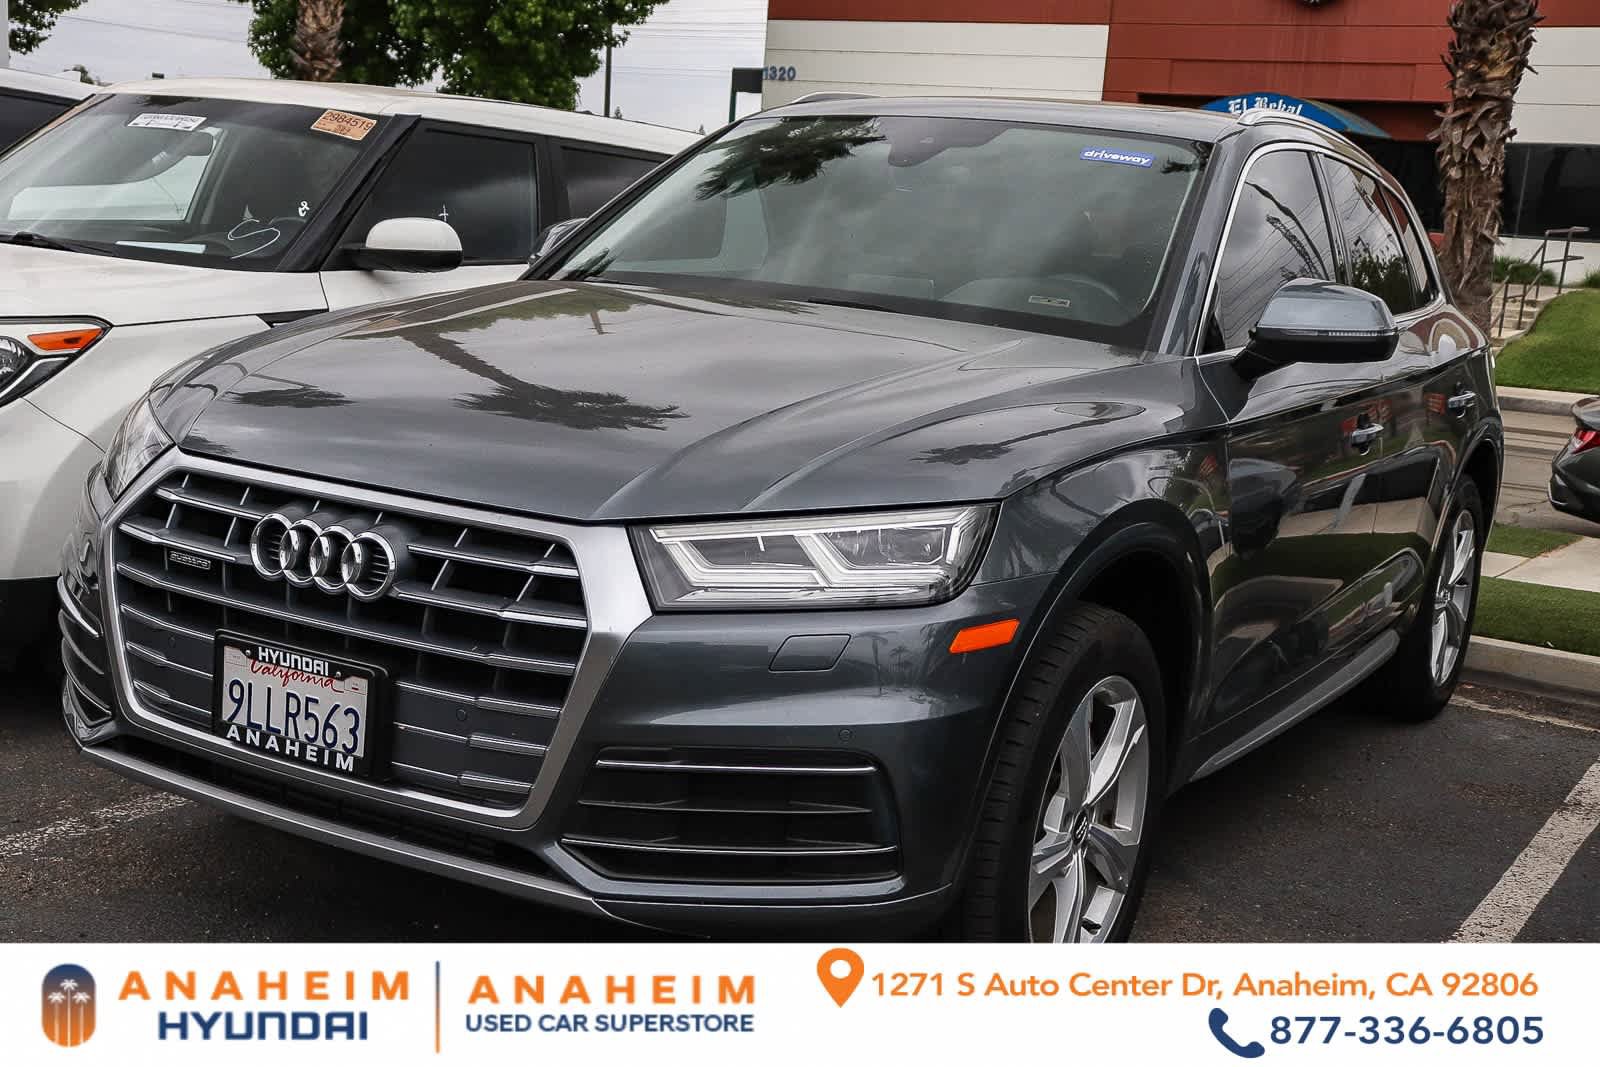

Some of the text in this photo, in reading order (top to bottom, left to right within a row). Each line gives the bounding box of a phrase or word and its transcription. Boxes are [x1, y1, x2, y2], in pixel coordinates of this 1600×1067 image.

[1084, 149, 1151, 165] driveway
[250, 658, 345, 694] California
[258, 646, 329, 677] HYUNDAI
[227, 678, 361, 755] 9LLR563
[226, 724, 355, 773] ANAHEIM
